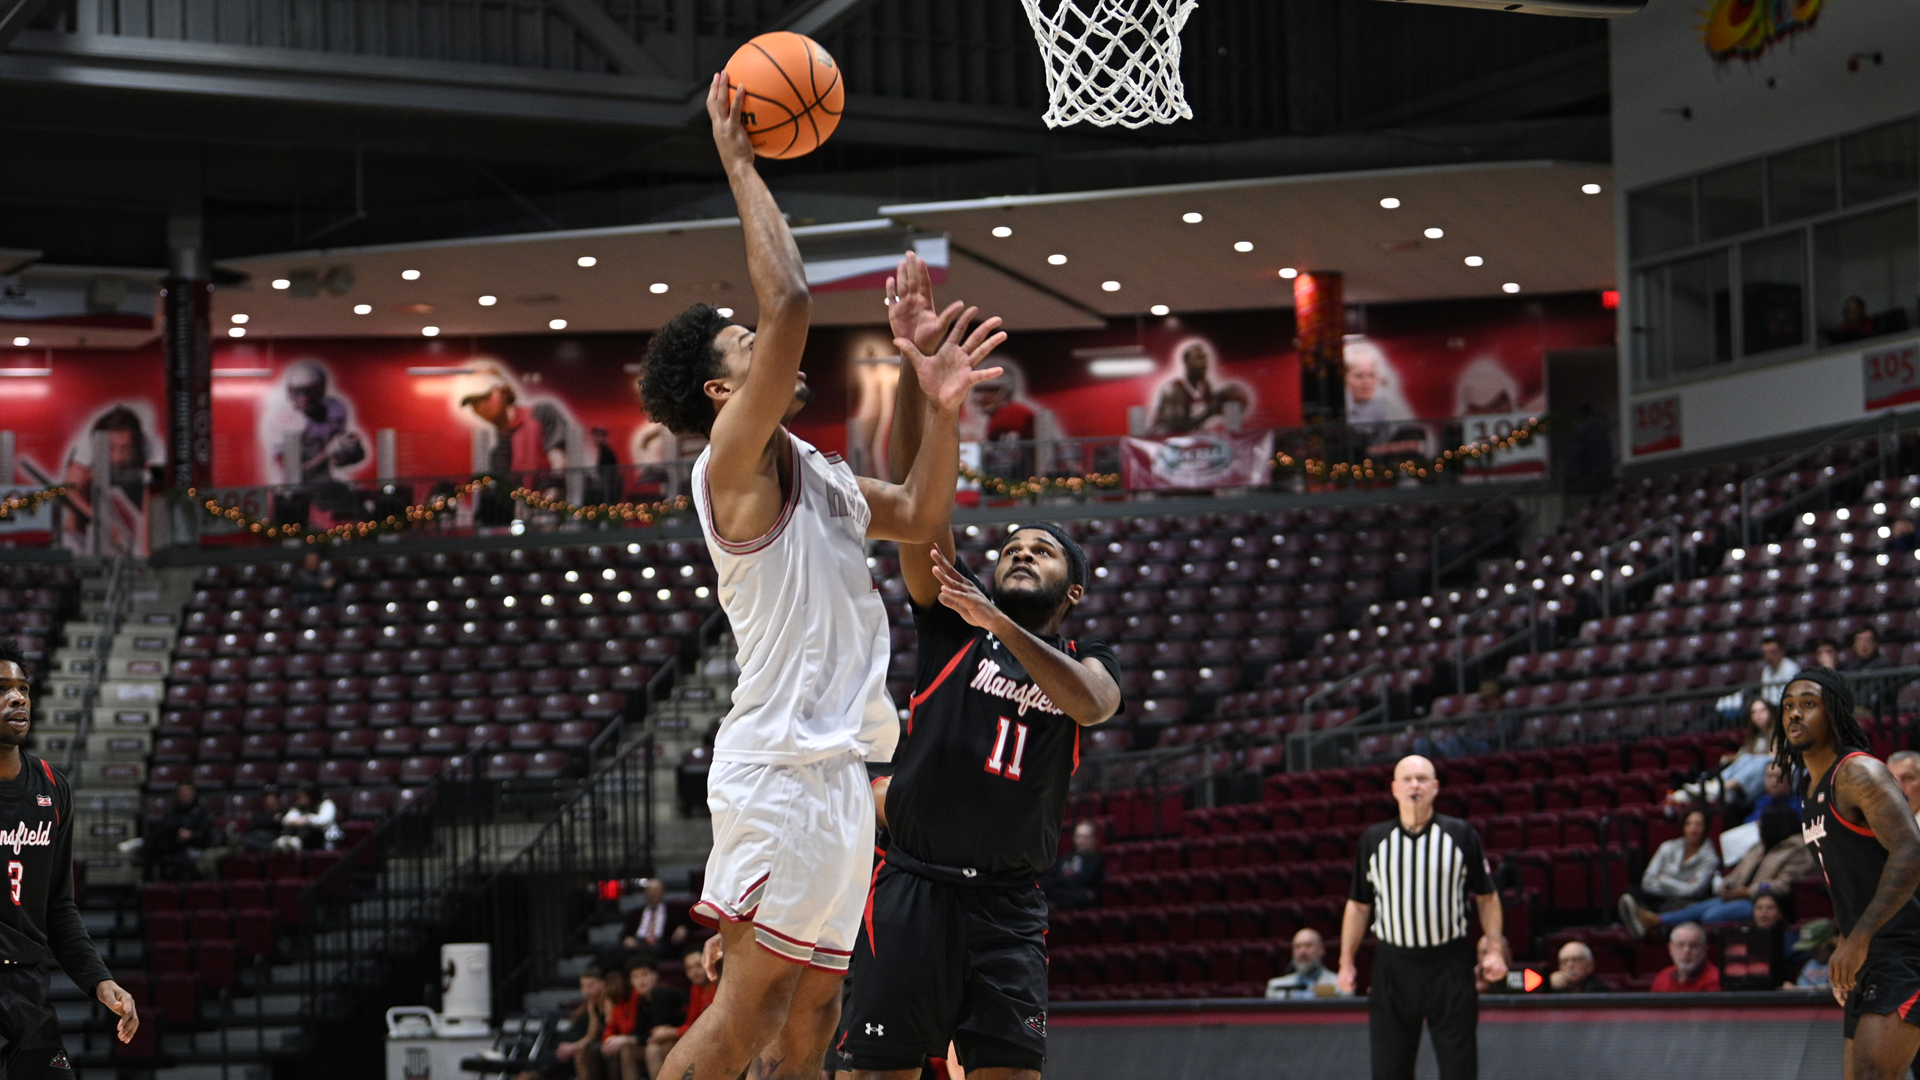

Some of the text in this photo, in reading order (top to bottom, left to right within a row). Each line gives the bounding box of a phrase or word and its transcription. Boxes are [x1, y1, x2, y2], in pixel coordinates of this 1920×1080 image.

[1868, 350, 1916, 384] 105
[1635, 401, 1677, 432] 105
[984, 714, 1029, 782] 11
[0, 820, 52, 856] nsfield
[8, 860, 24, 906] 3
